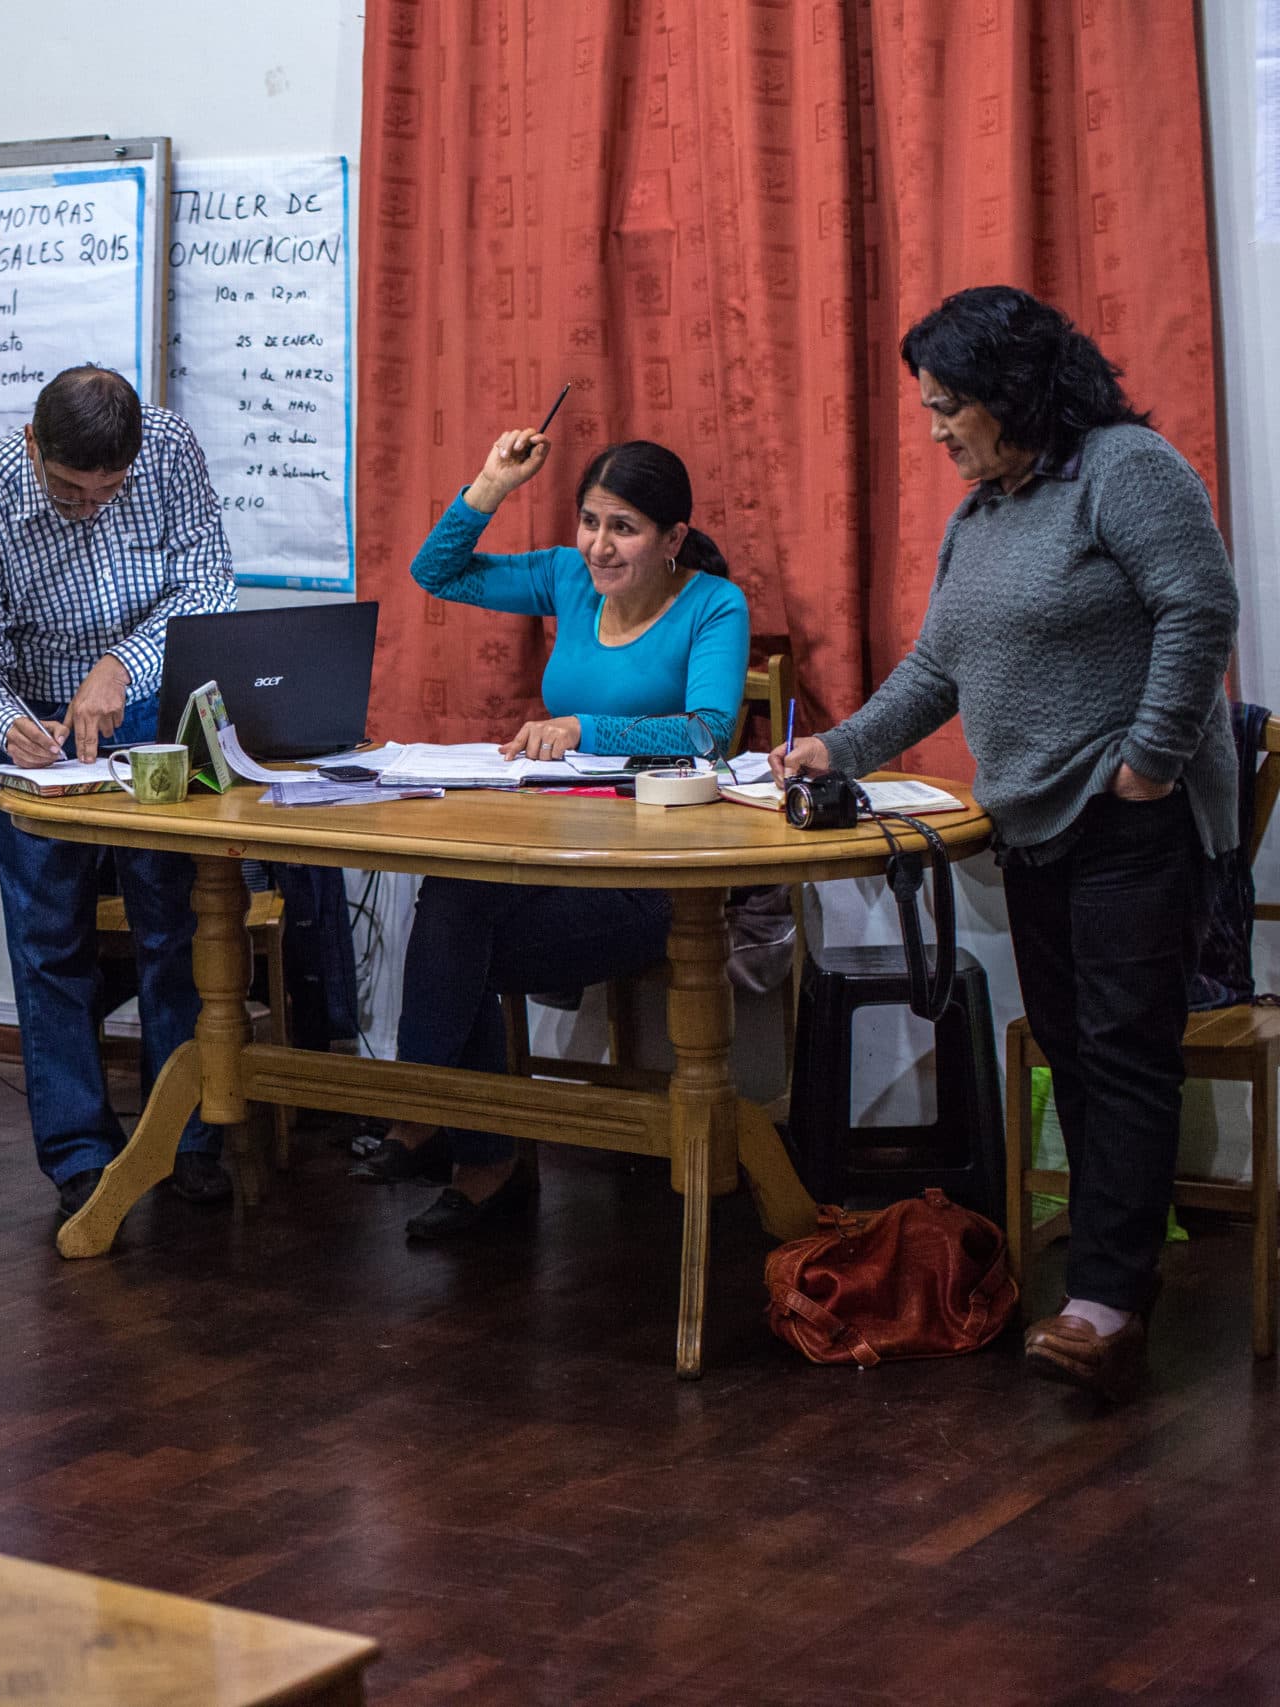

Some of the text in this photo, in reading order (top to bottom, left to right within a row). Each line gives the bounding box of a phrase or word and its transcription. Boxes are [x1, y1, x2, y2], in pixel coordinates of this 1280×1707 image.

[170, 190, 323, 225] TALLER DE
[79, 233, 129, 266] 2015
[260, 367, 275, 382] de
[285, 369, 334, 383] MARZO
[261, 398, 275, 412] de
[267, 431, 282, 444] de
[254, 676, 284, 687] acer
